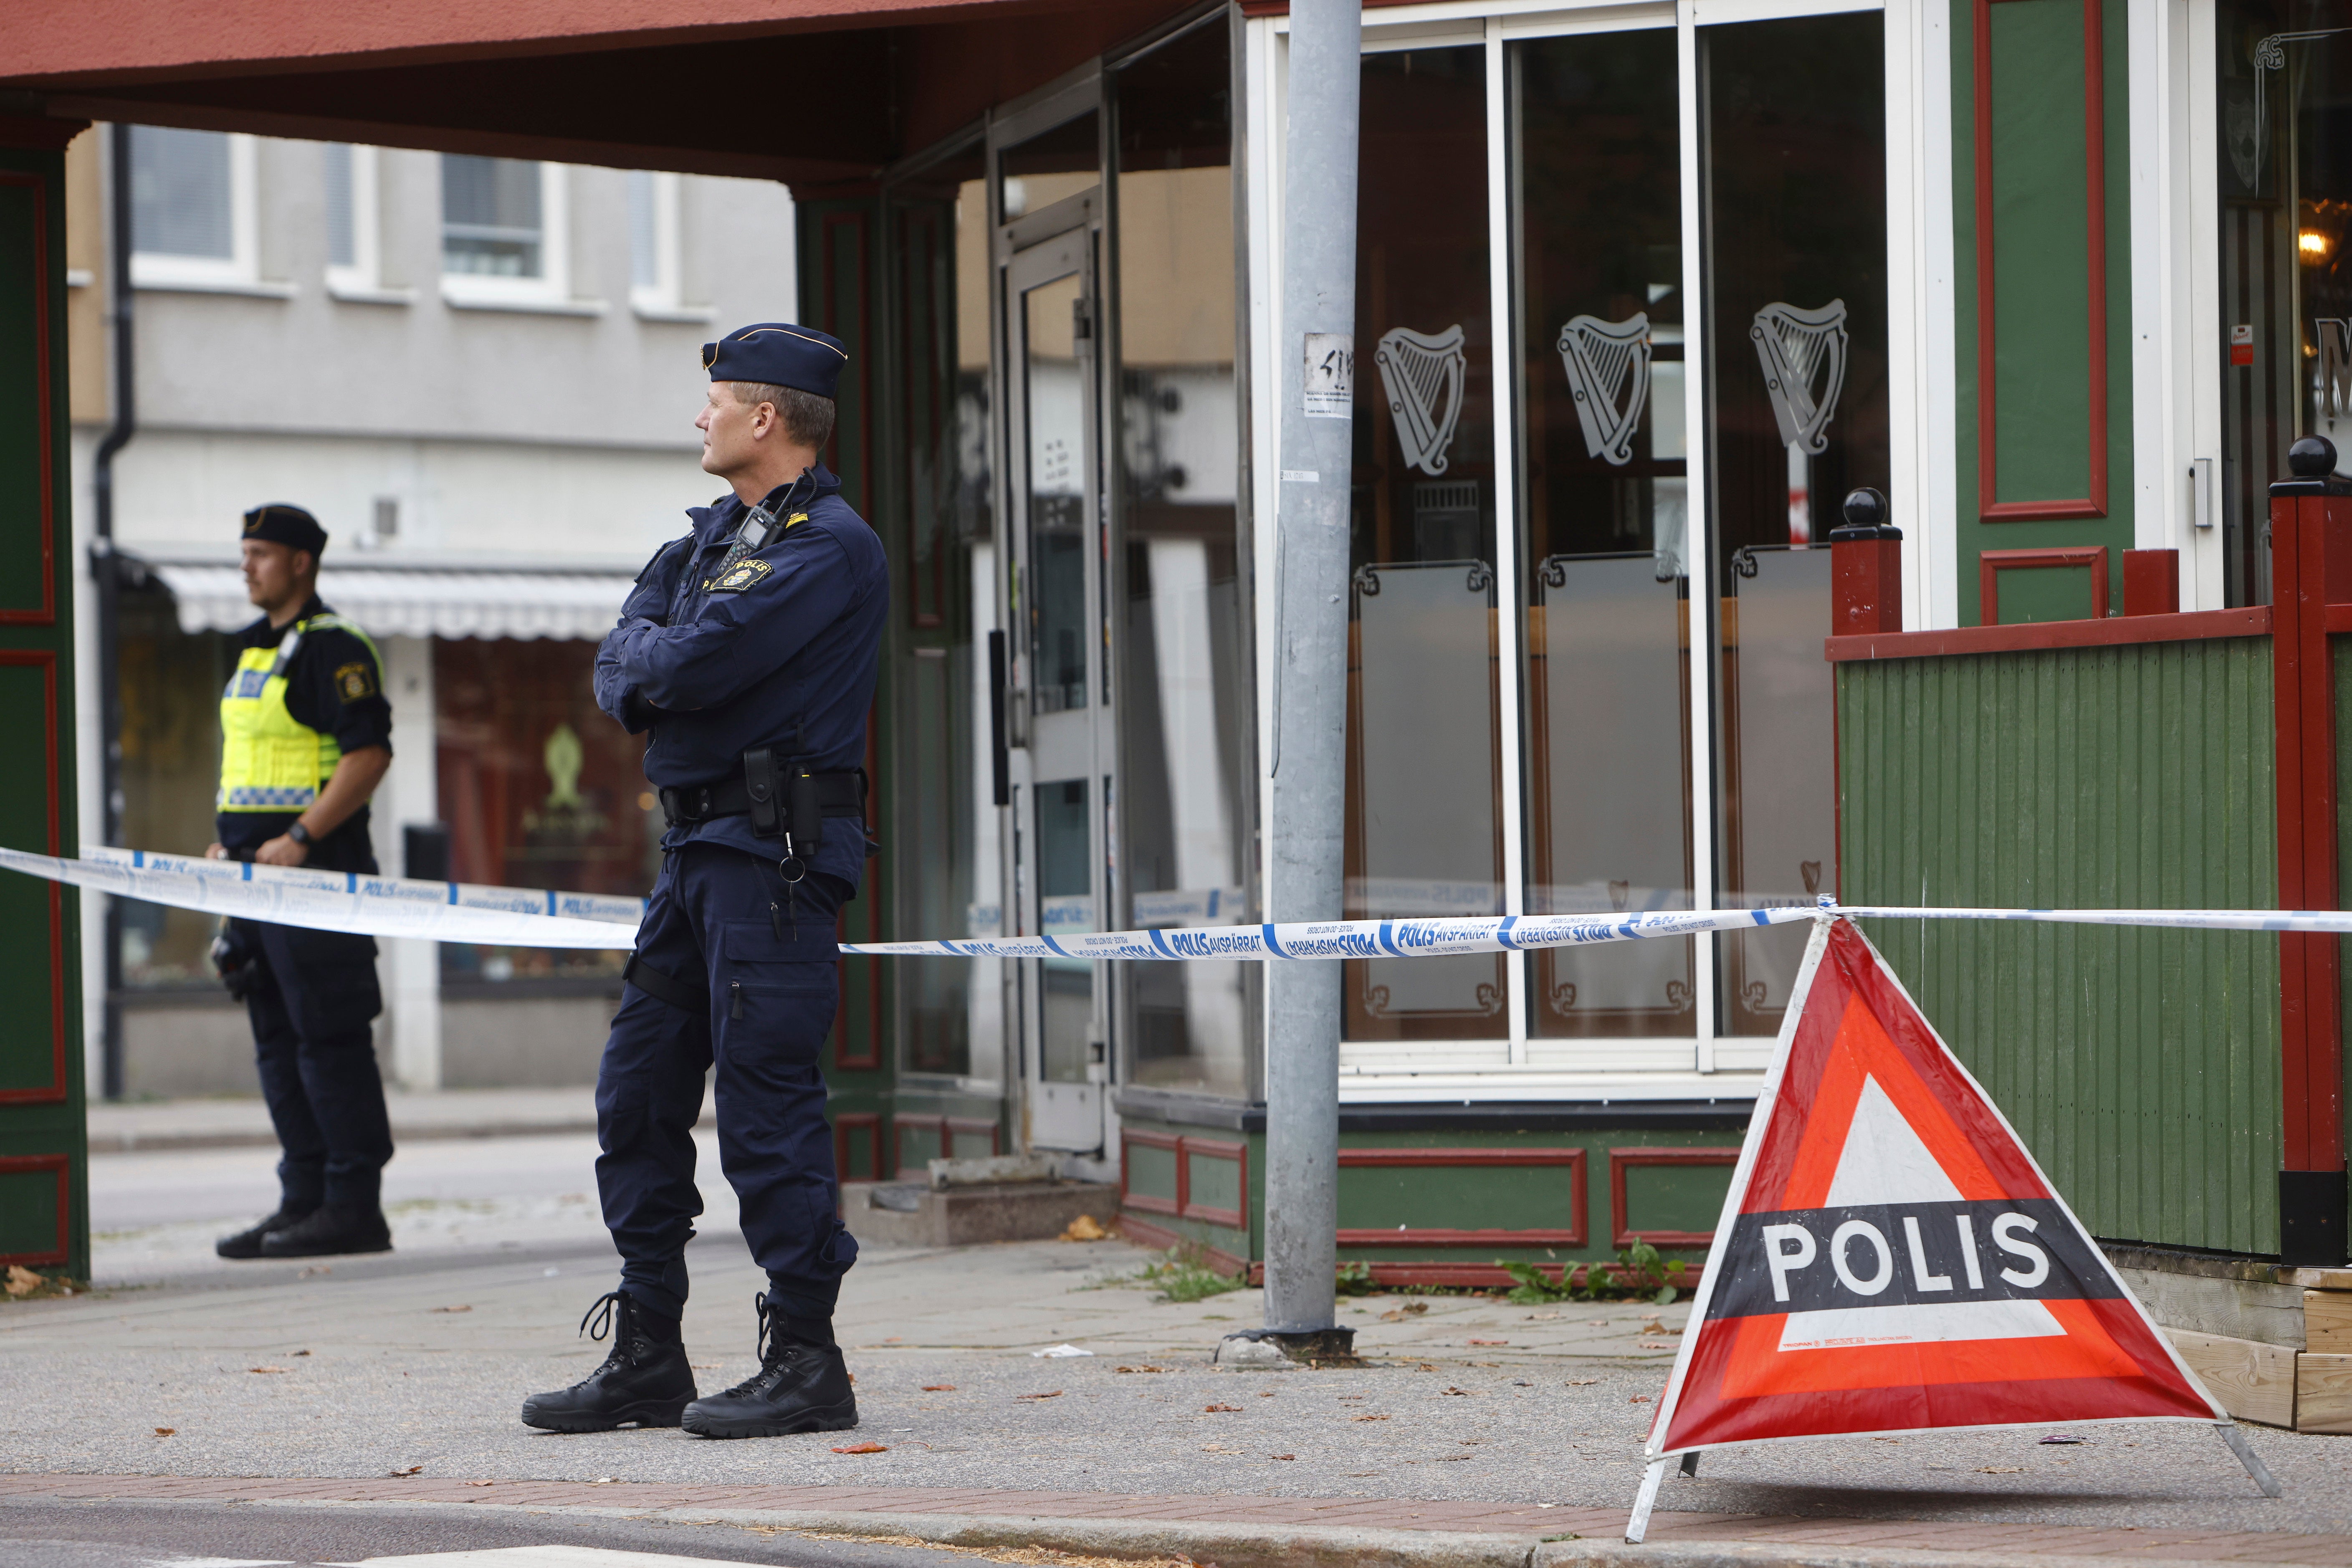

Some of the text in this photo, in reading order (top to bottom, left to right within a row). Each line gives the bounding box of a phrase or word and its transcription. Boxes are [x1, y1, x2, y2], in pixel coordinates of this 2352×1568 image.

[736, 561, 767, 572] POLIS
[1573, 923, 1616, 942] POLIS
[1699, 919, 1717, 928] CROSS
[1171, 933, 1262, 956] POLIS AVSPÄRRAT
[1285, 933, 1383, 957] POLIS AVSPÄRRAT
[1398, 922, 1498, 948] POLIS AVSPÄRRAT
[961, 943, 1003, 955] POLIS
[1762, 1212, 2050, 1302] POLIS
